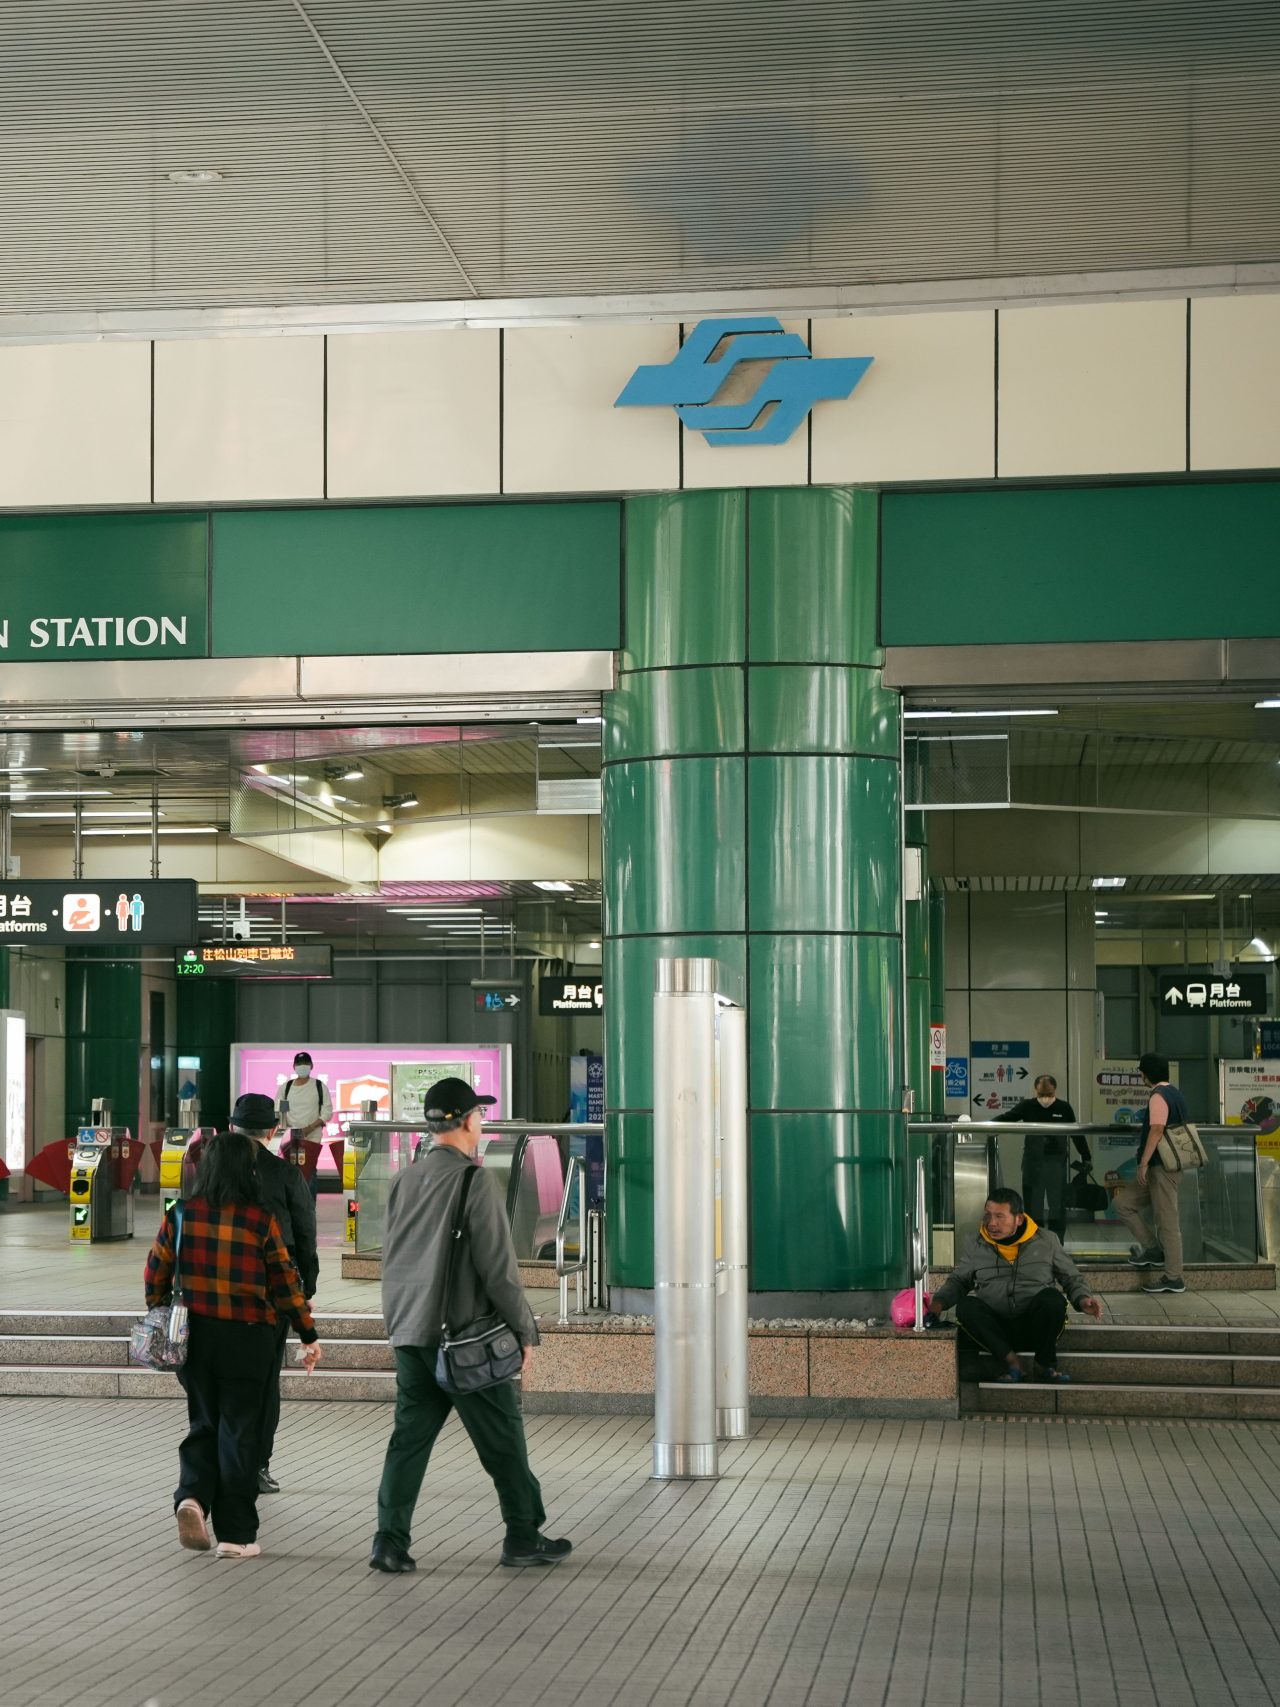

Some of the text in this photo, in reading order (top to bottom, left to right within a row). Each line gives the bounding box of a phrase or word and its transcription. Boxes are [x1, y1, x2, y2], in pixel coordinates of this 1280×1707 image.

[29, 615, 188, 649] STATION
[177, 964, 205, 975] 12:20
[562, 984, 592, 1000] 月台
[1209, 982, 1241, 998] 月台
[552, 999, 593, 1009] Platforms
[1209, 999, 1252, 1008] Platforms
